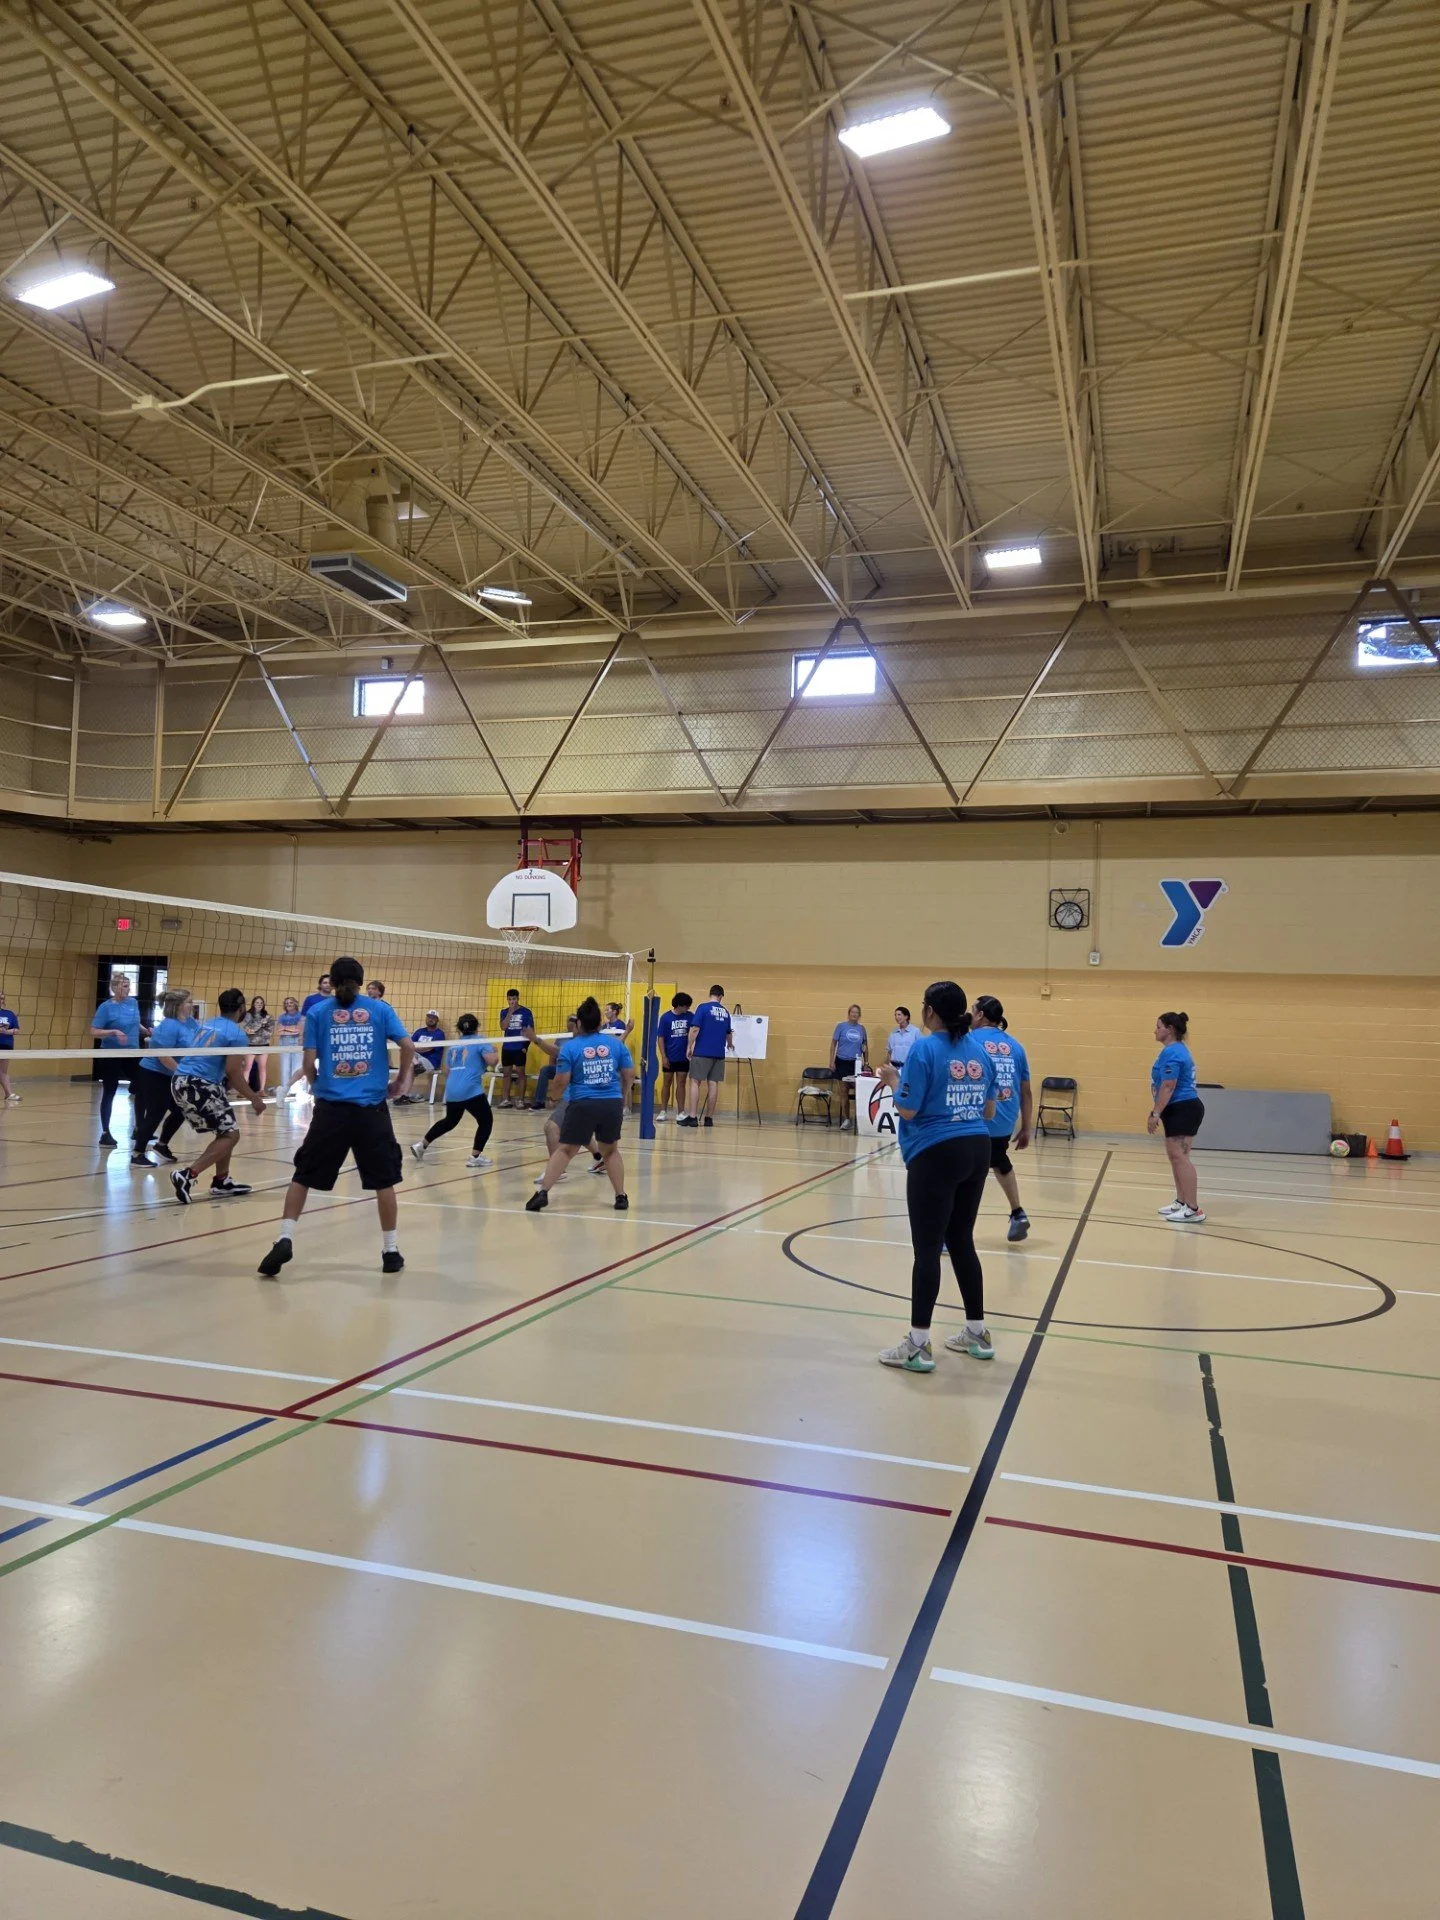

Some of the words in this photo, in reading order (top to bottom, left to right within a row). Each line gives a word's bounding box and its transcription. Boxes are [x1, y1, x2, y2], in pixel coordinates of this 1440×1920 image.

[1187, 928, 1202, 944] YMCA
[330, 1026, 374, 1034] EVERYTHING
[330, 1033, 374, 1045] HURTS
[331, 1051, 373, 1061] HUNGRY
[583, 1064, 613, 1074] HURTS
[946, 1084, 985, 1093] EVERYTHING
[945, 1092, 984, 1107] HURTS
